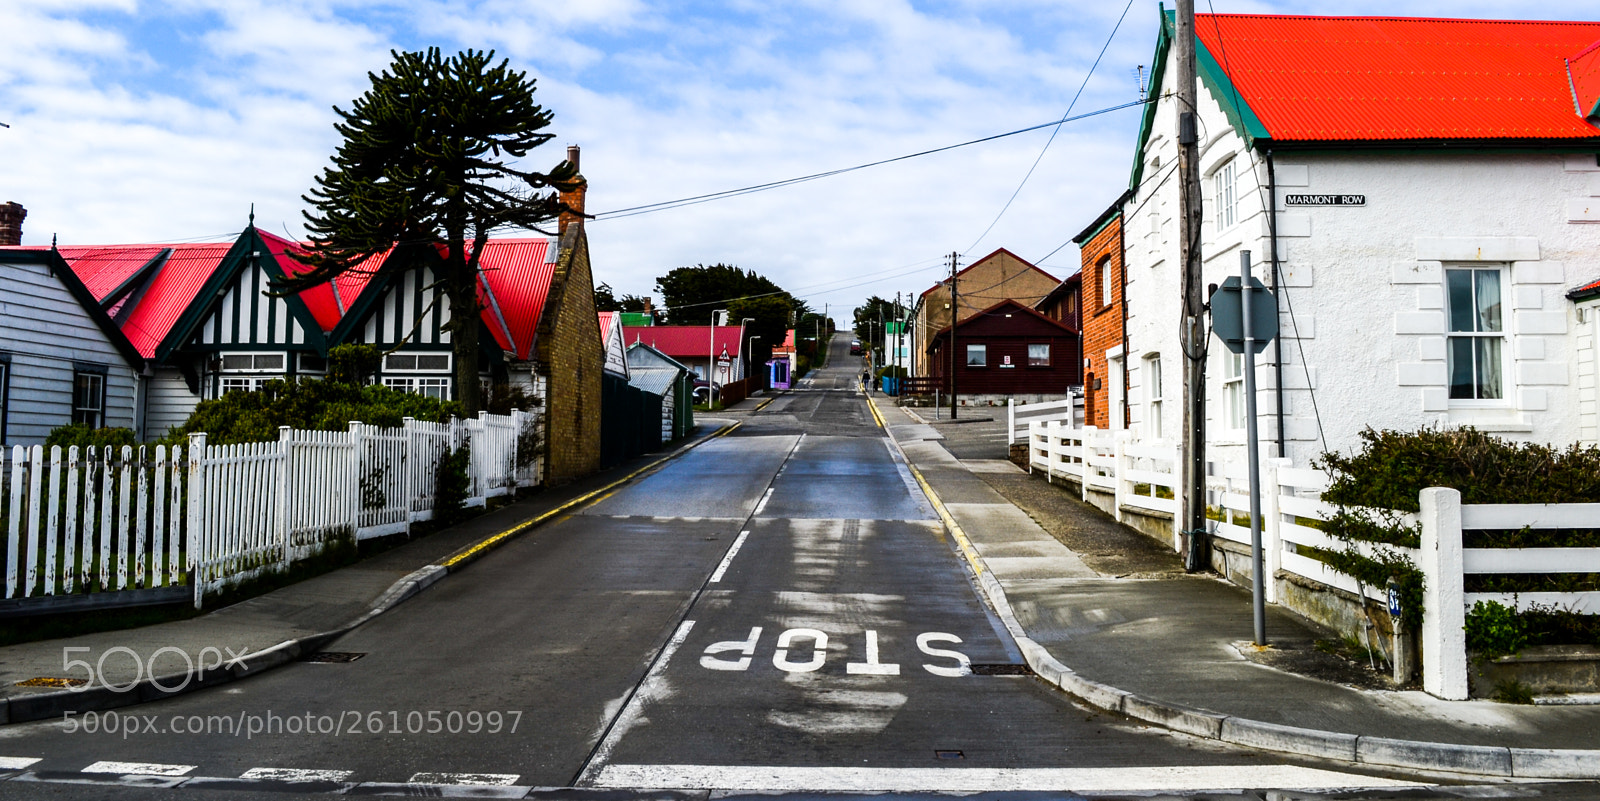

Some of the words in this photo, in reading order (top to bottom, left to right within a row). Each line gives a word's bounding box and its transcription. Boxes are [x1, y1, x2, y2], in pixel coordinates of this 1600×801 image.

[1287, 195, 1337, 204] MARMONT
[1342, 195, 1363, 204] ROW
[700, 626, 971, 677] STOP
